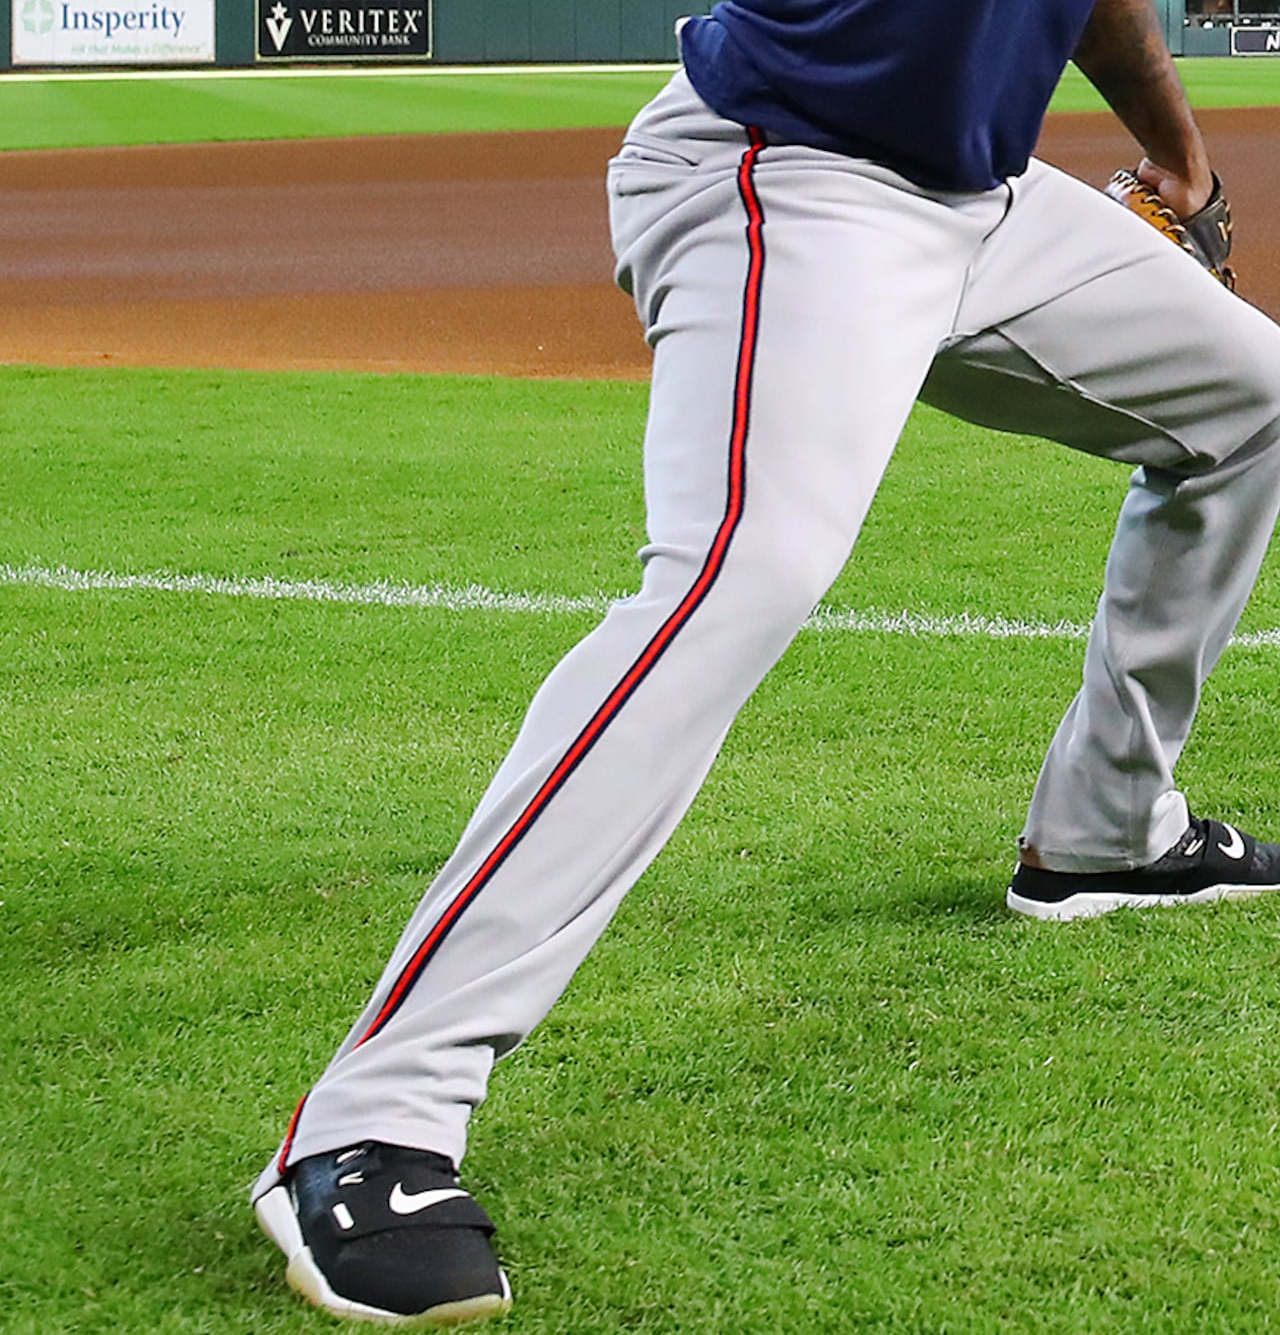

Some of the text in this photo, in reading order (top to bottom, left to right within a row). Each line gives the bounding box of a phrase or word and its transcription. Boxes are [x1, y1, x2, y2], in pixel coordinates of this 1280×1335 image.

[61, 2, 186, 38] Insperity
[300, 9, 419, 34] VERITEX
[308, 34, 411, 47] COMMUNITY BANK
